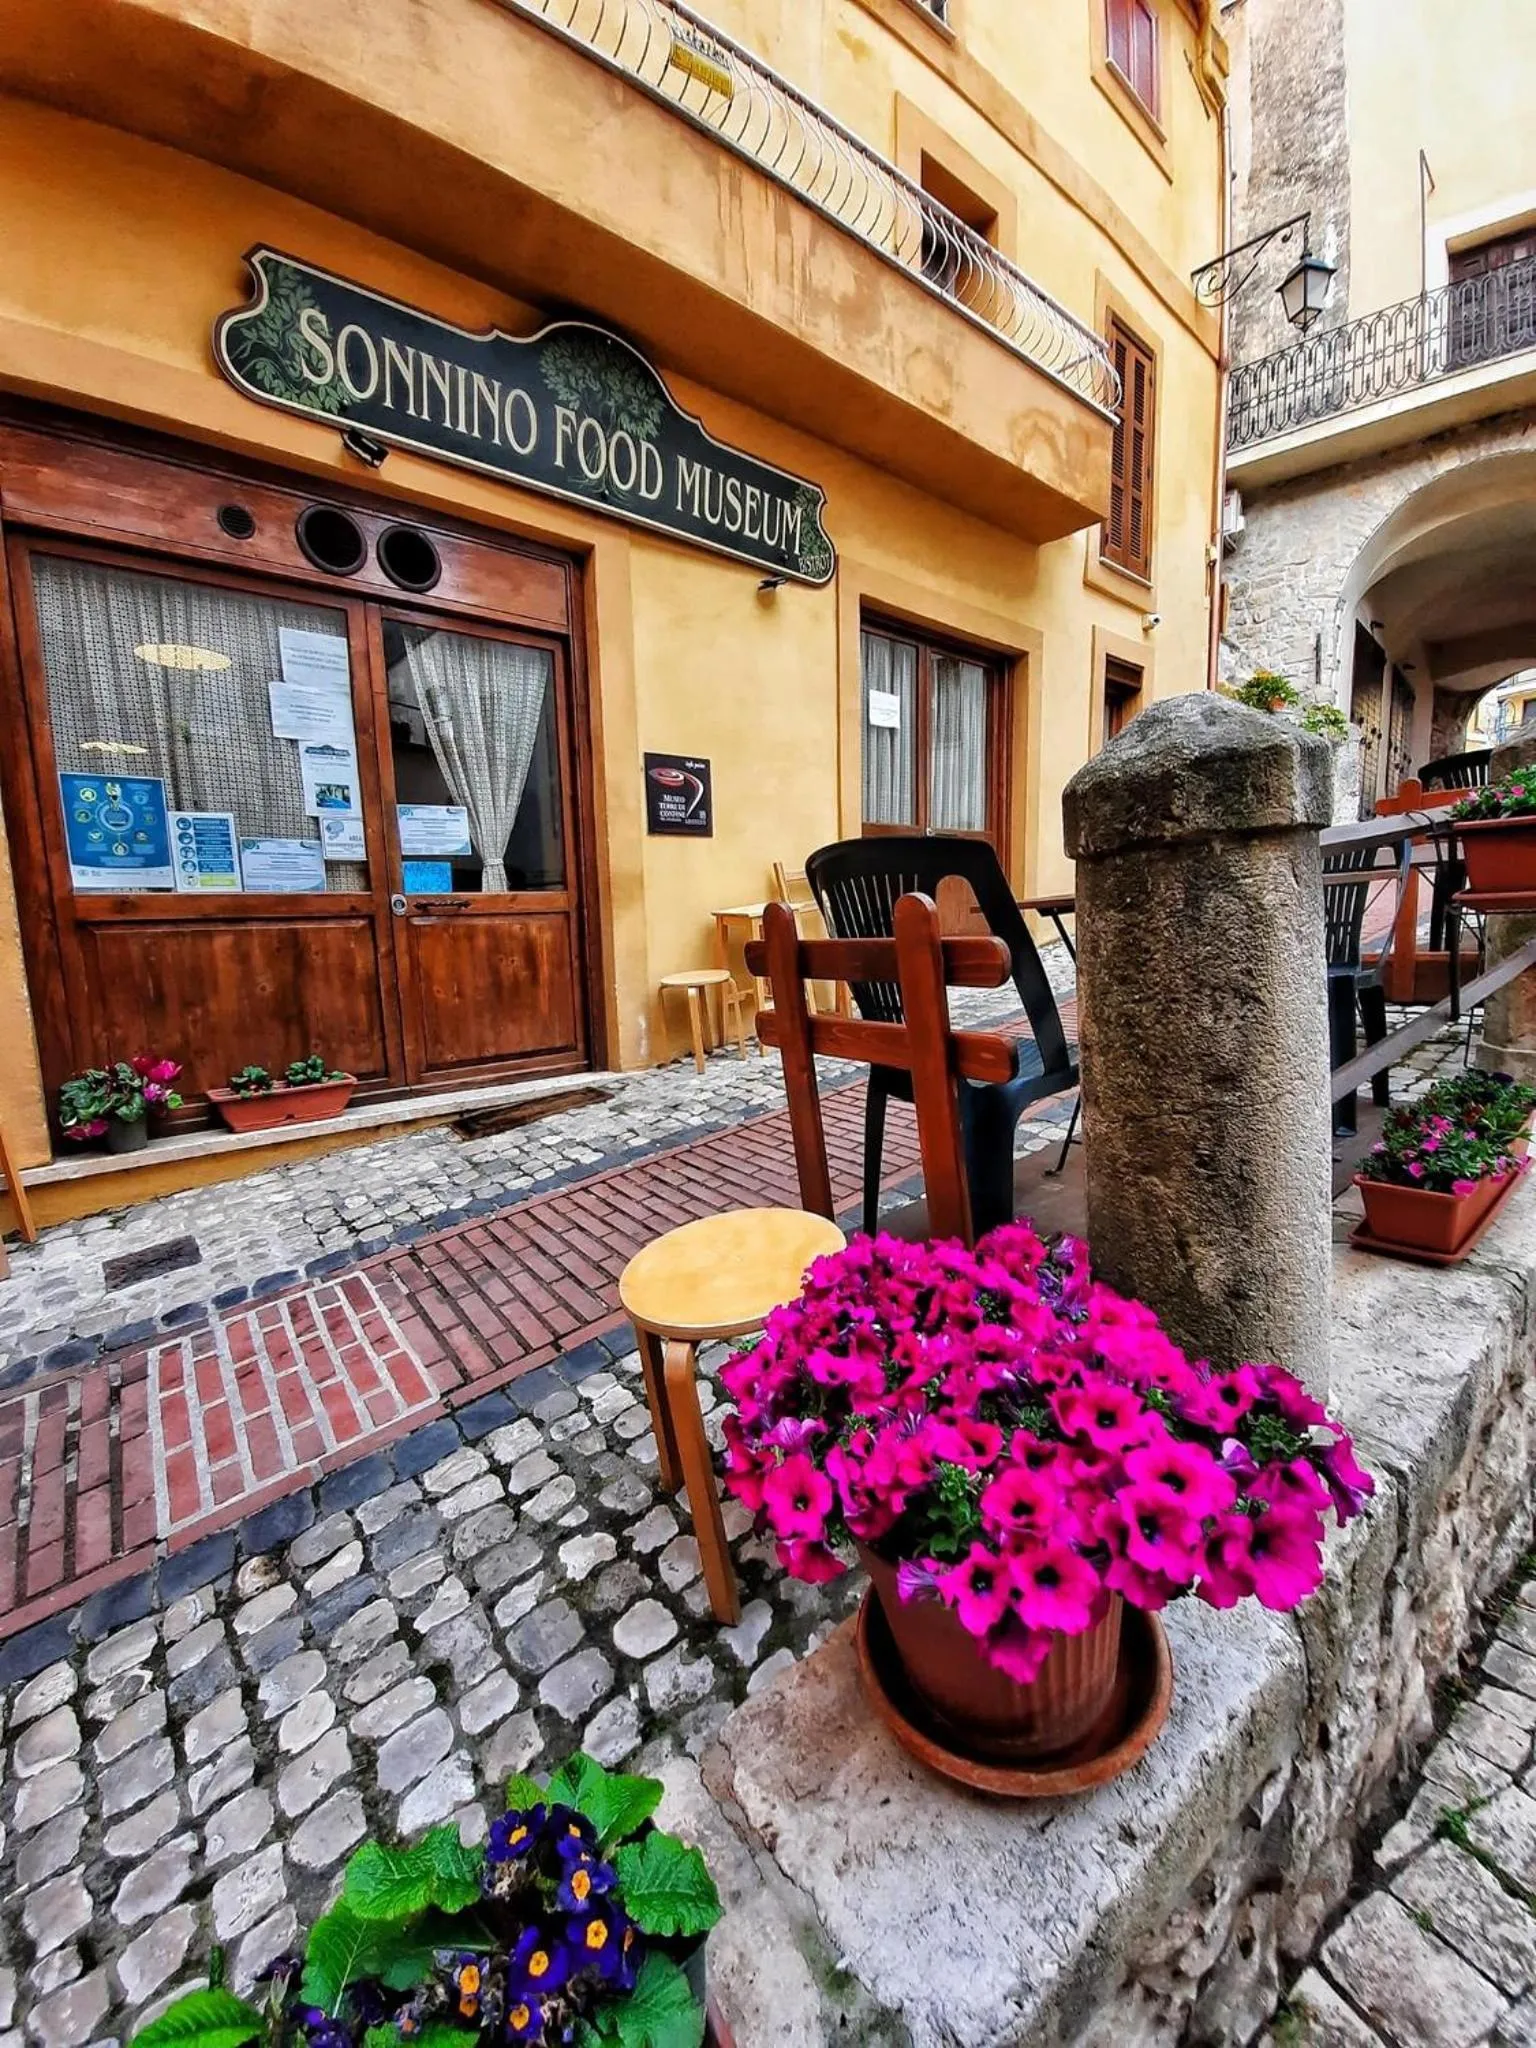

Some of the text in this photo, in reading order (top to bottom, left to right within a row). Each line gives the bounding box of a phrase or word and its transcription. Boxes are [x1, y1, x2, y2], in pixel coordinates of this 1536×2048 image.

[301, 308, 803, 556] SONNINO FOOD MUSEUM
